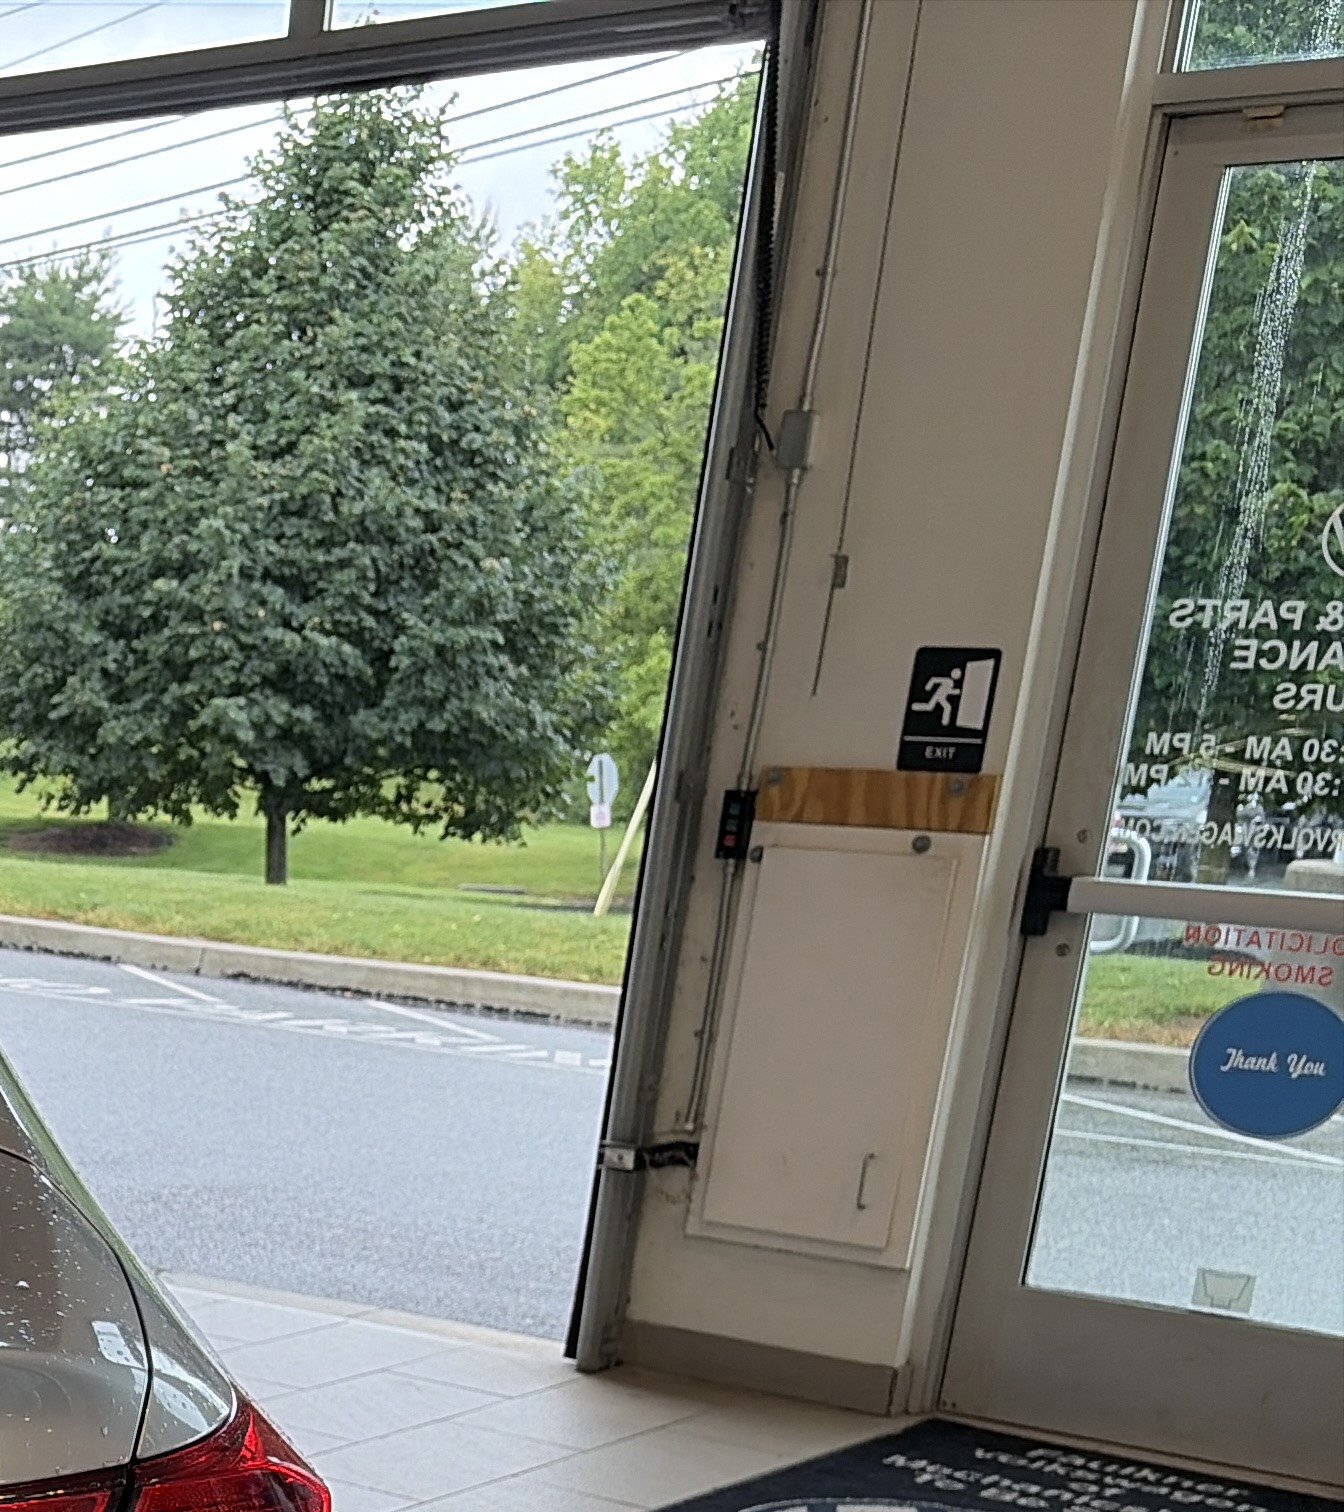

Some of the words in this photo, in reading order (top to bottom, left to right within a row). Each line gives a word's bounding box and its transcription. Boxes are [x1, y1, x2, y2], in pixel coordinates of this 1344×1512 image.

[924, 746, 956, 759] EXIT
[1220, 1048, 1280, 1073] Thank
[1288, 1053, 1326, 1079] You
